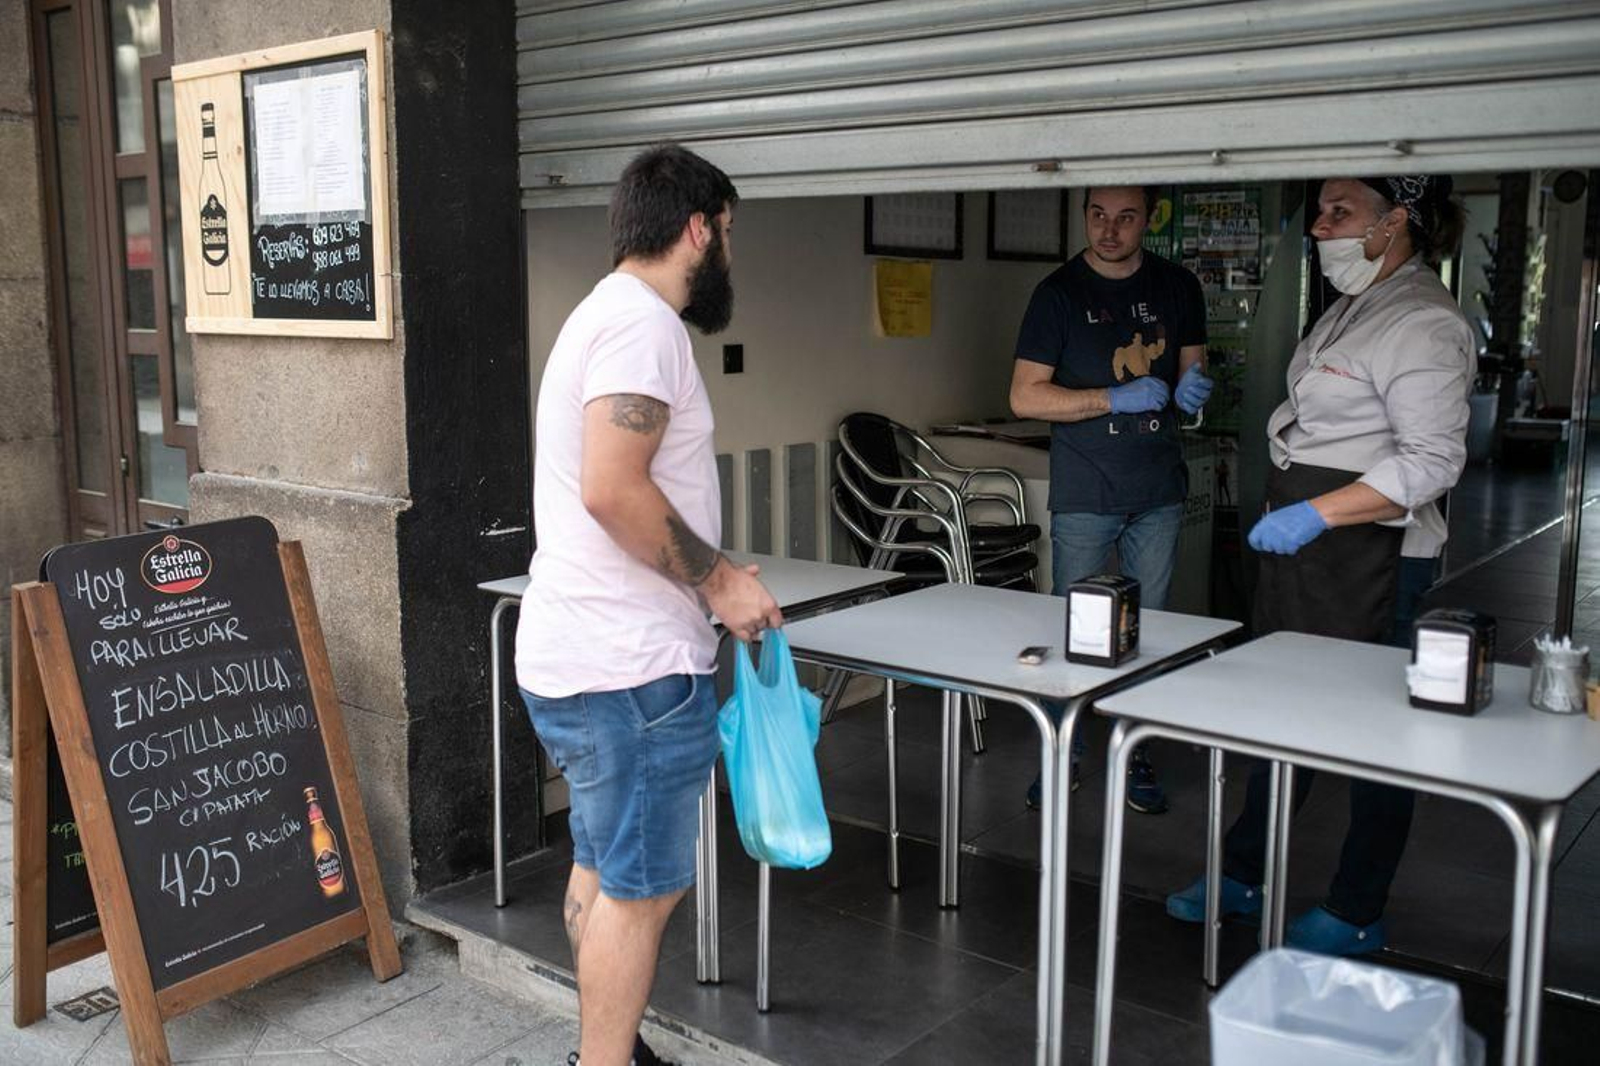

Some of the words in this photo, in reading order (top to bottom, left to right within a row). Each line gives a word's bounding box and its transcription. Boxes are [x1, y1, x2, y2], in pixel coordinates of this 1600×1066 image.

[323, 282, 331, 299] A
[150, 549, 202, 571] Estrella
[154, 564, 203, 584] Galicia
[74, 567, 127, 610] HOY
[111, 656, 292, 730] ENSALADILLA
[109, 715, 232, 778] COSTILLA
[127, 779, 188, 826] SAN
[192, 750, 288, 799] JACOBO
